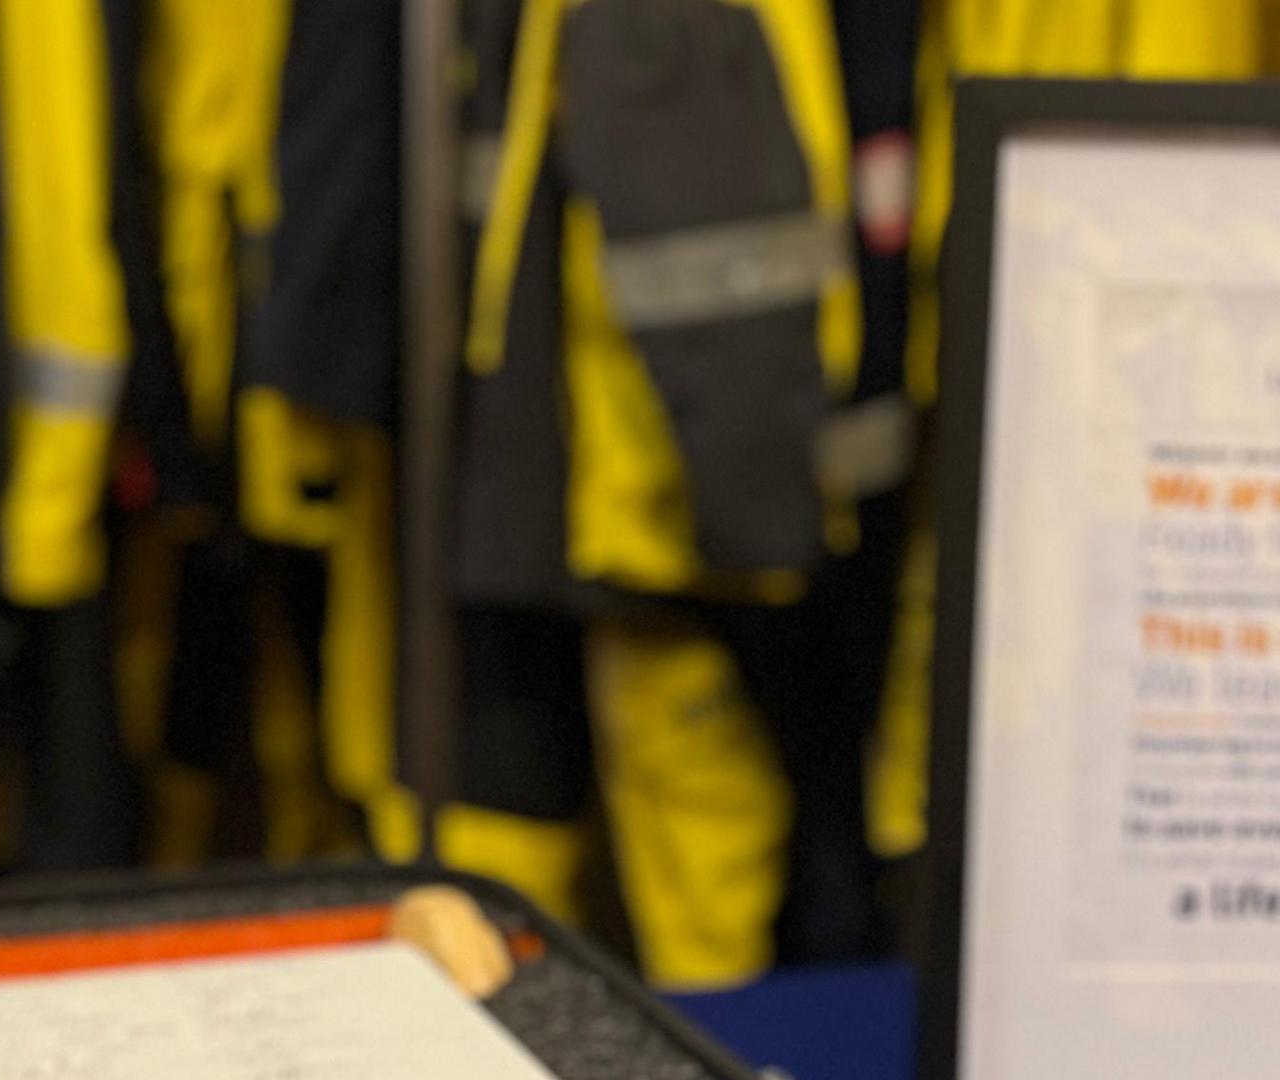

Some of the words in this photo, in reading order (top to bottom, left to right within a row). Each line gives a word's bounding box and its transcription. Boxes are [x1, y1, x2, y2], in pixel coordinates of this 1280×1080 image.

[1146, 474, 1212, 511] We
[1140, 615, 1223, 653] This
[1237, 618, 1268, 653] is
[1134, 666, 1197, 701] We
[1174, 888, 1200, 920] a
